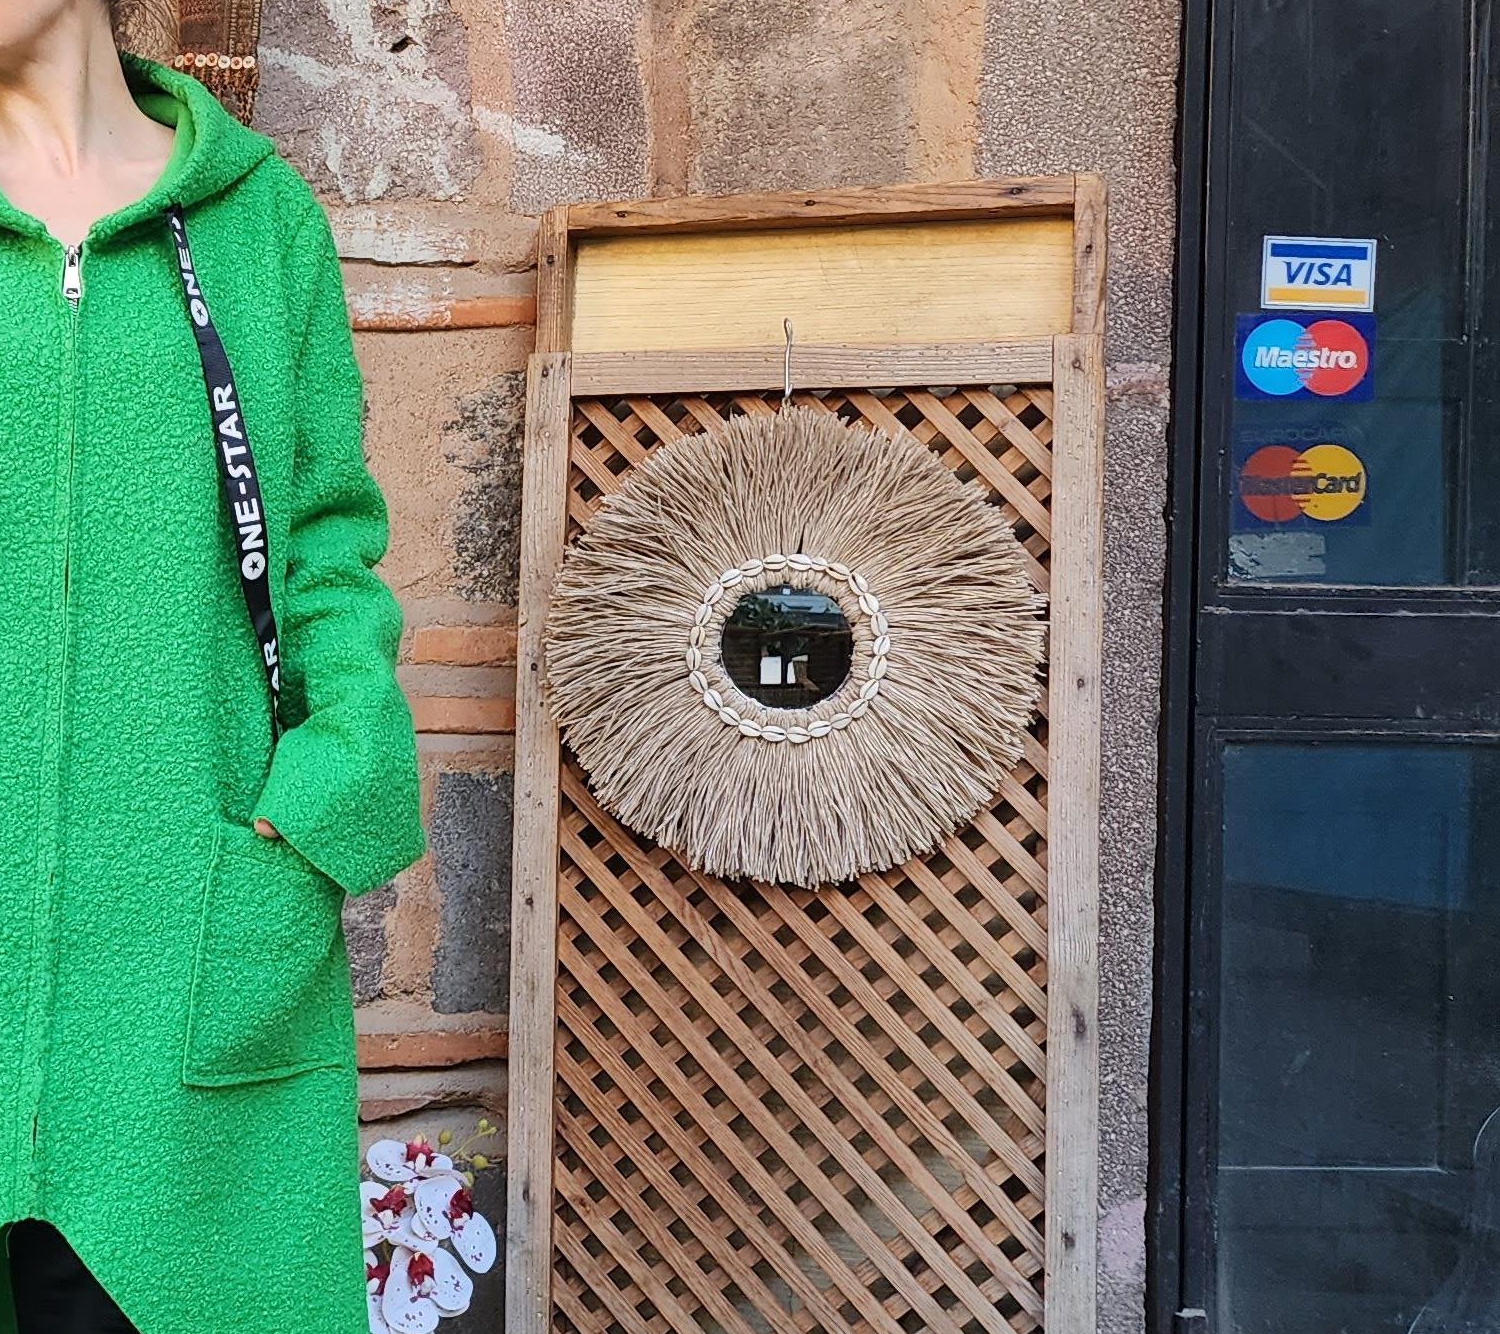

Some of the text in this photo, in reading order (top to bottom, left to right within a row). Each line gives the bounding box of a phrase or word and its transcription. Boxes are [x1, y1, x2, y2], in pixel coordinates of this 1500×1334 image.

[1284, 260, 1353, 287] VISA
[1254, 345, 1358, 369] Maestro
[214, 383, 266, 581] ONE-STAR
